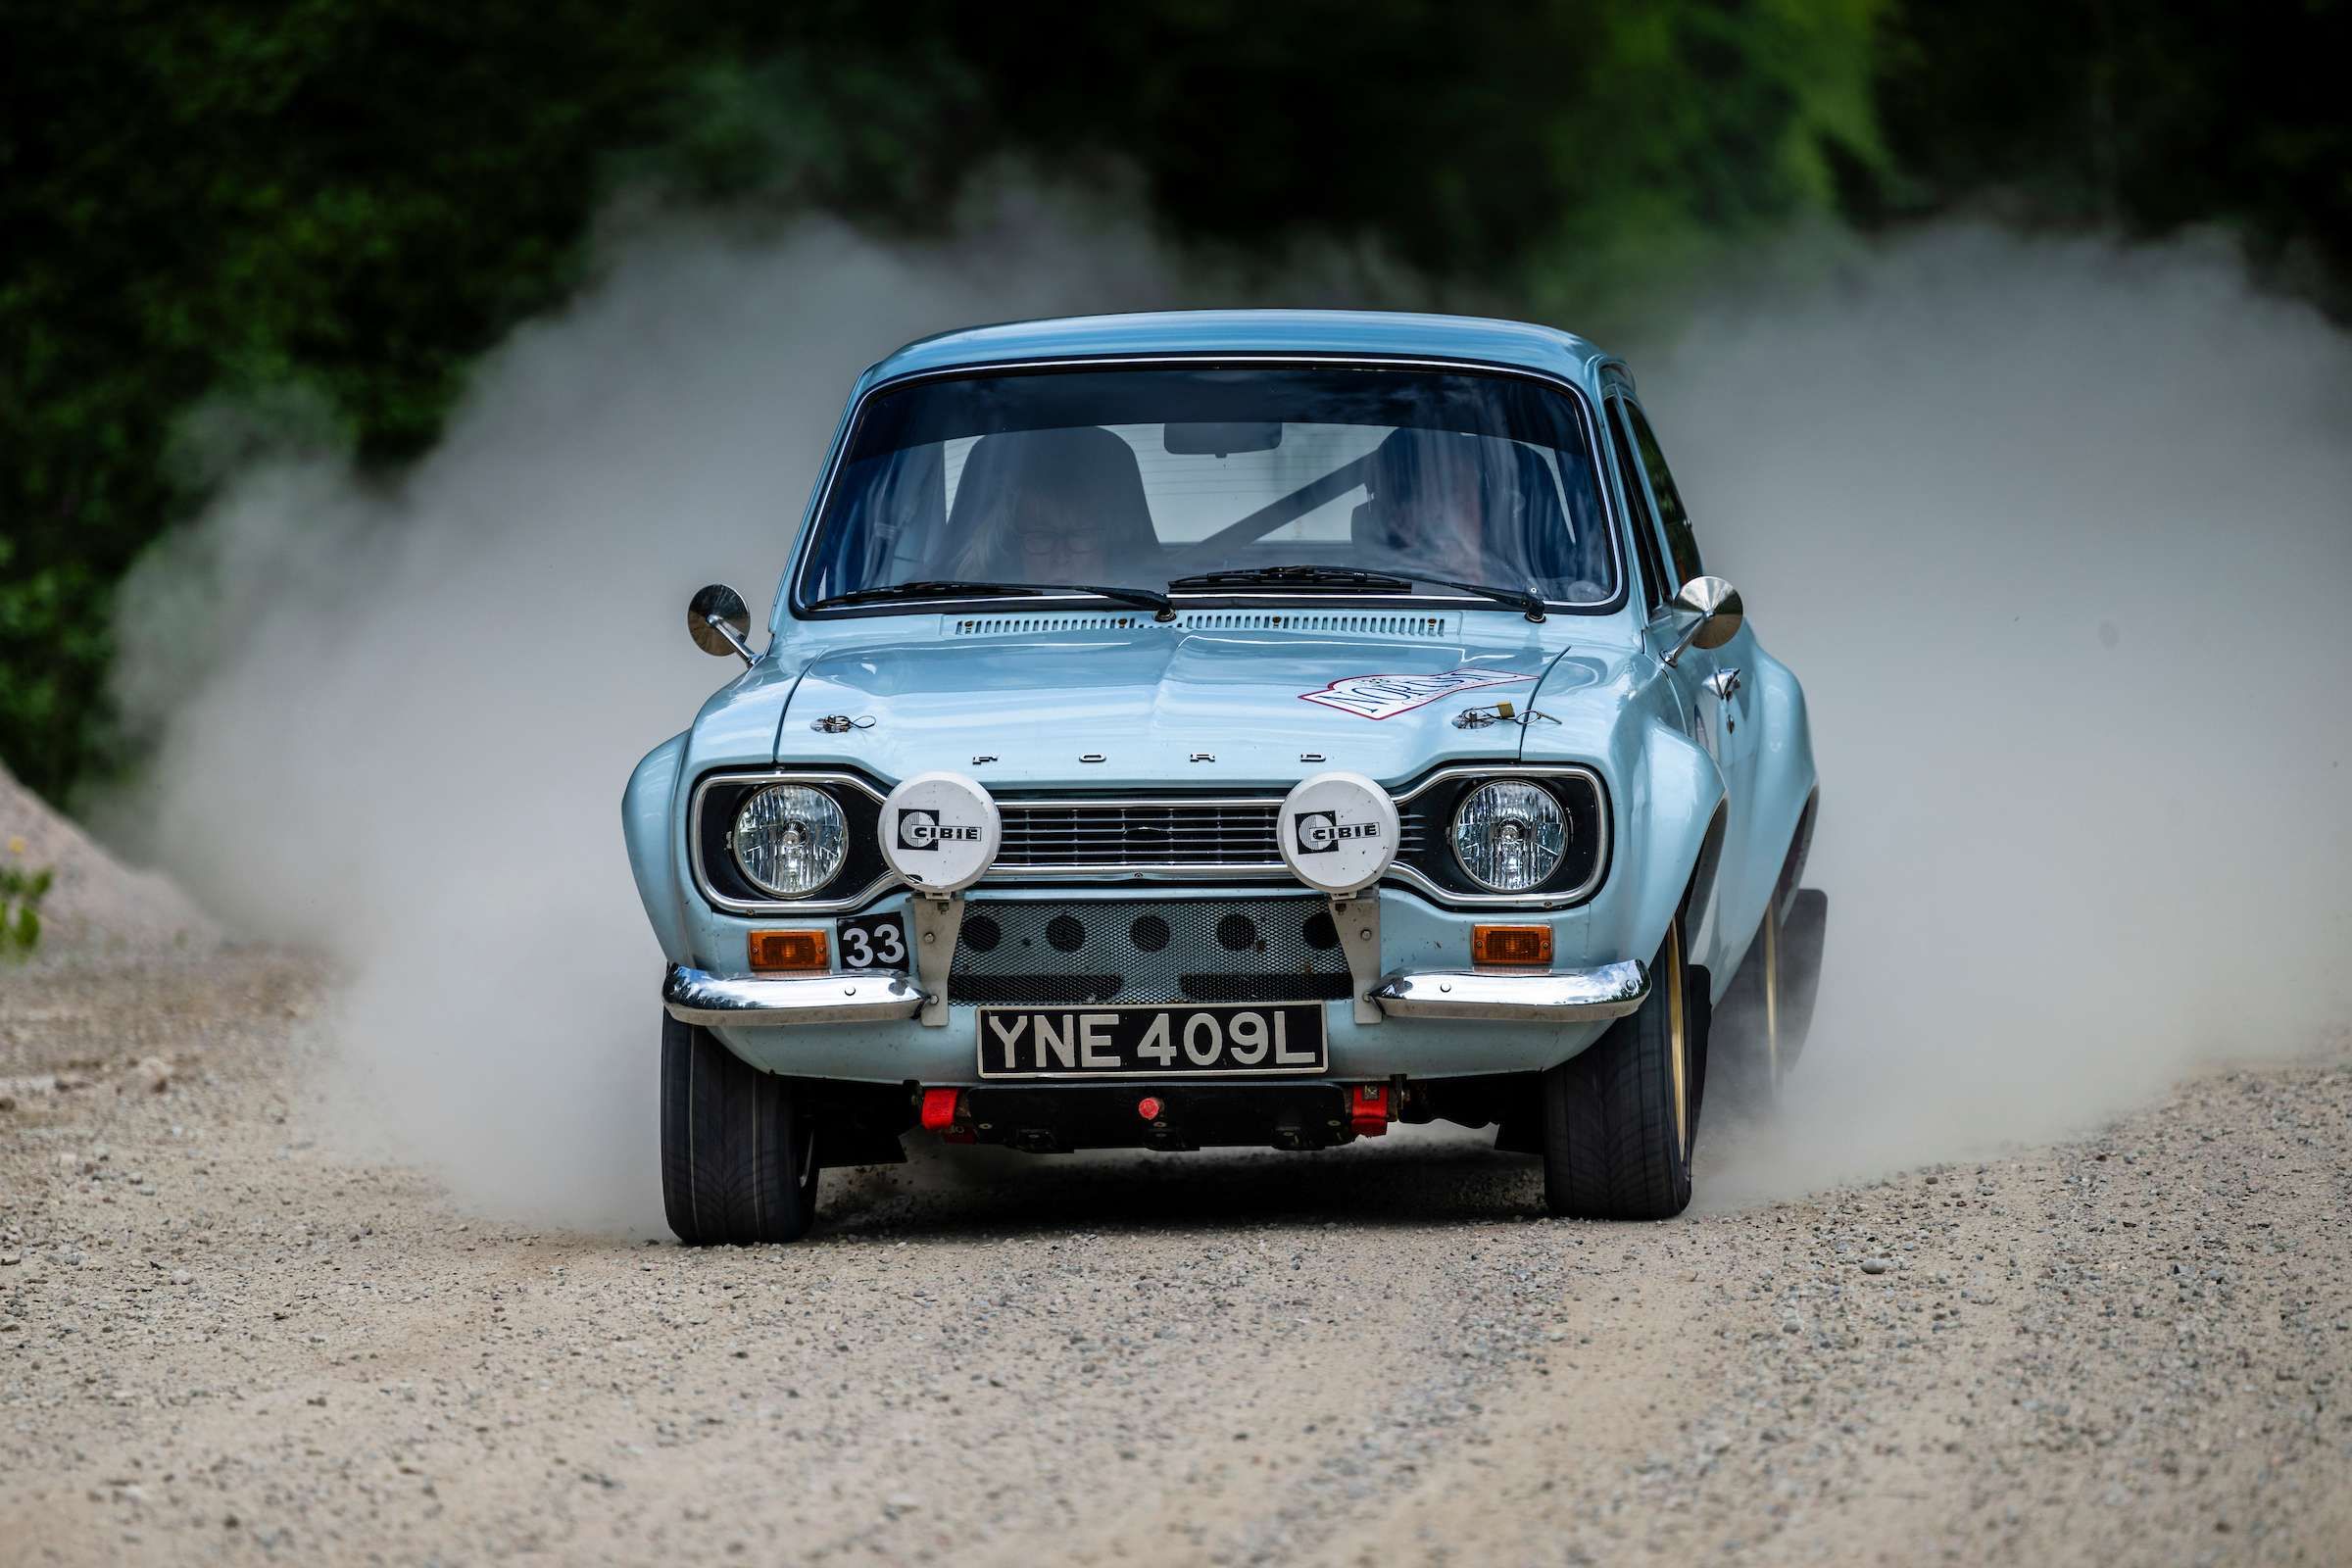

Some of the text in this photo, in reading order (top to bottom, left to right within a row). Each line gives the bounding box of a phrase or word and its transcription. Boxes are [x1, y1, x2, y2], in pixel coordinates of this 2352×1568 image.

[972, 752, 1326, 764] FORD
[843, 923, 905, 967] 33
[989, 1010, 1316, 1068] YNE 409L
